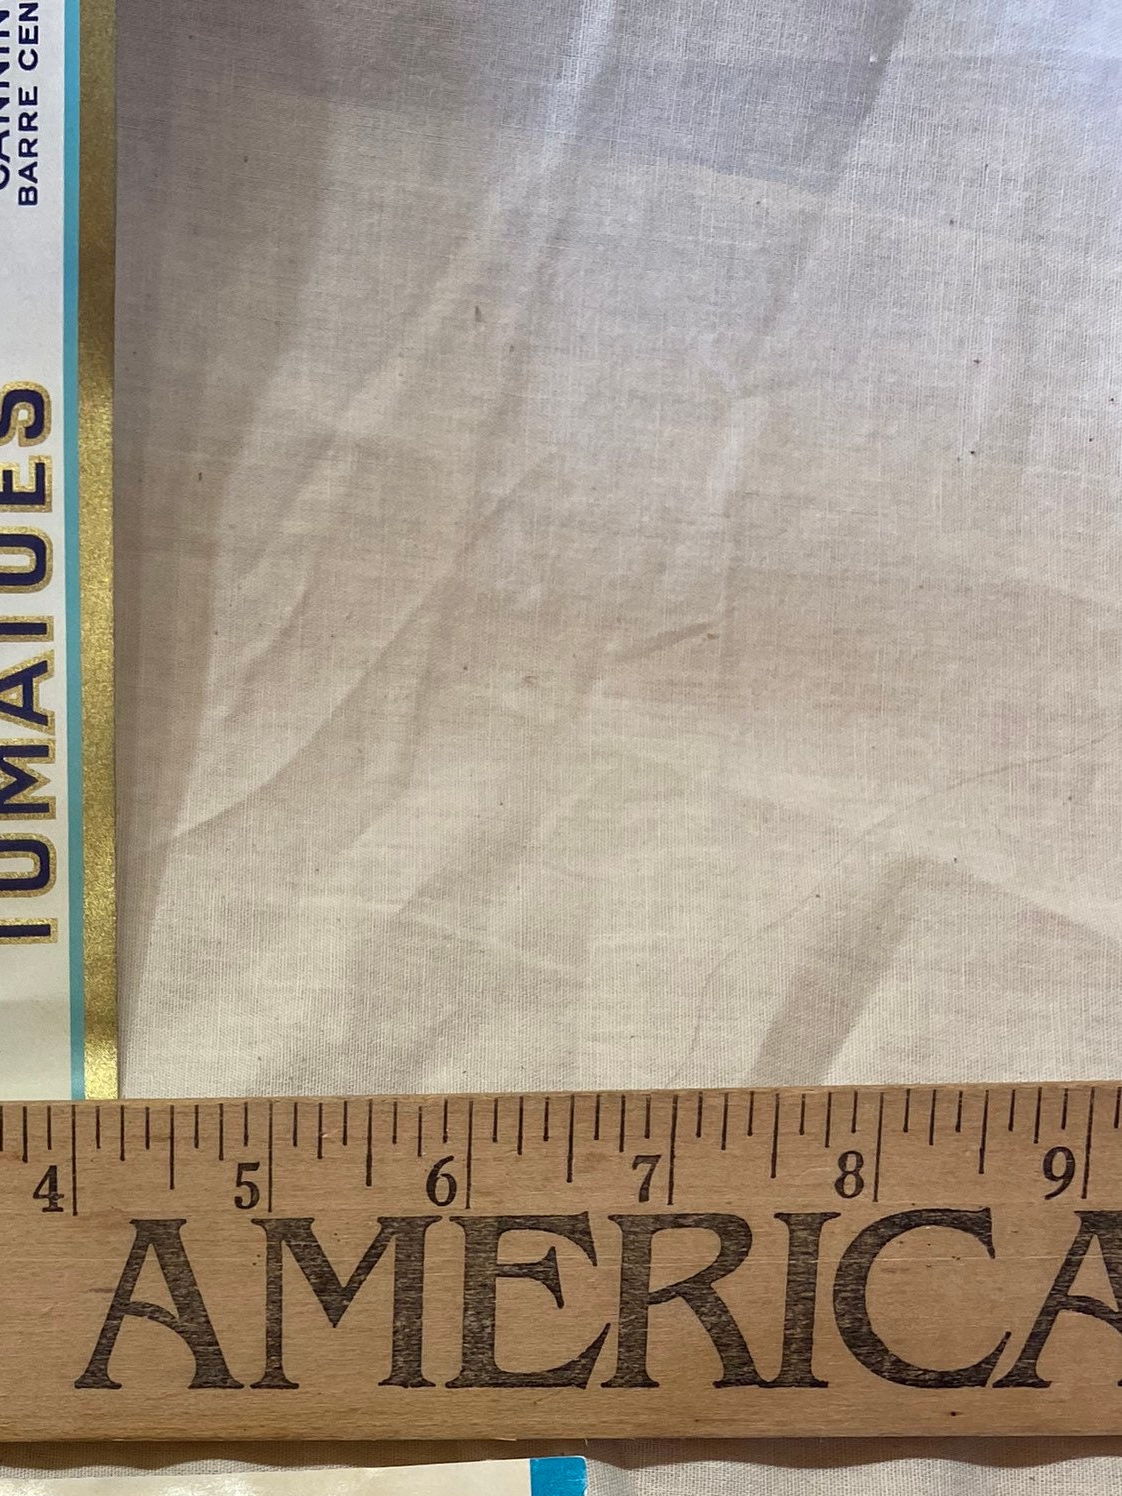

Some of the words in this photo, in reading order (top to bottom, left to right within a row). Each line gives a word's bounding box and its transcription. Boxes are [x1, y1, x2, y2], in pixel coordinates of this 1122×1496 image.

[18, 2, 39, 71] CEN
[18, 86, 38, 207] BARRE
[31, 1165, 65, 1213] 4
[233, 1160, 261, 1210] 5
[425, 1155, 458, 1207] 6
[630, 1155, 662, 1203] 7
[833, 1150, 866, 1199] 8
[1042, 1146, 1076, 1199] 9
[74, 1207, 1122, 1392] AMERICA
